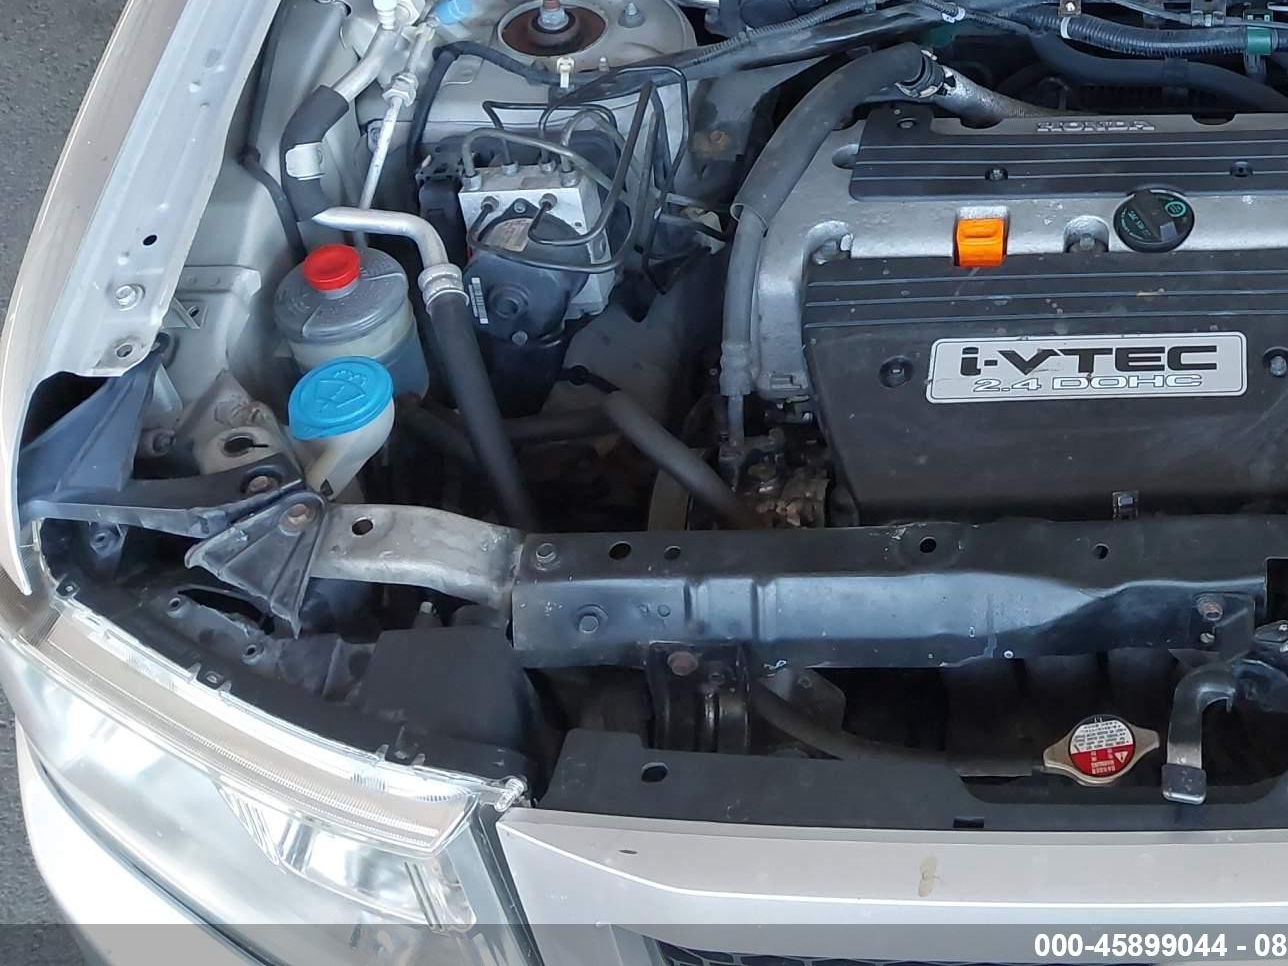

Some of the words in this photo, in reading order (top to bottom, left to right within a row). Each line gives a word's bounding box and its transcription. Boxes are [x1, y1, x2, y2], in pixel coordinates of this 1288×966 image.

[1036, 121, 1155, 132] HONDA
[960, 345, 1218, 376] i-VTEC
[973, 378, 1042, 393] 2.4
[1051, 374, 1204, 391] DOHC
